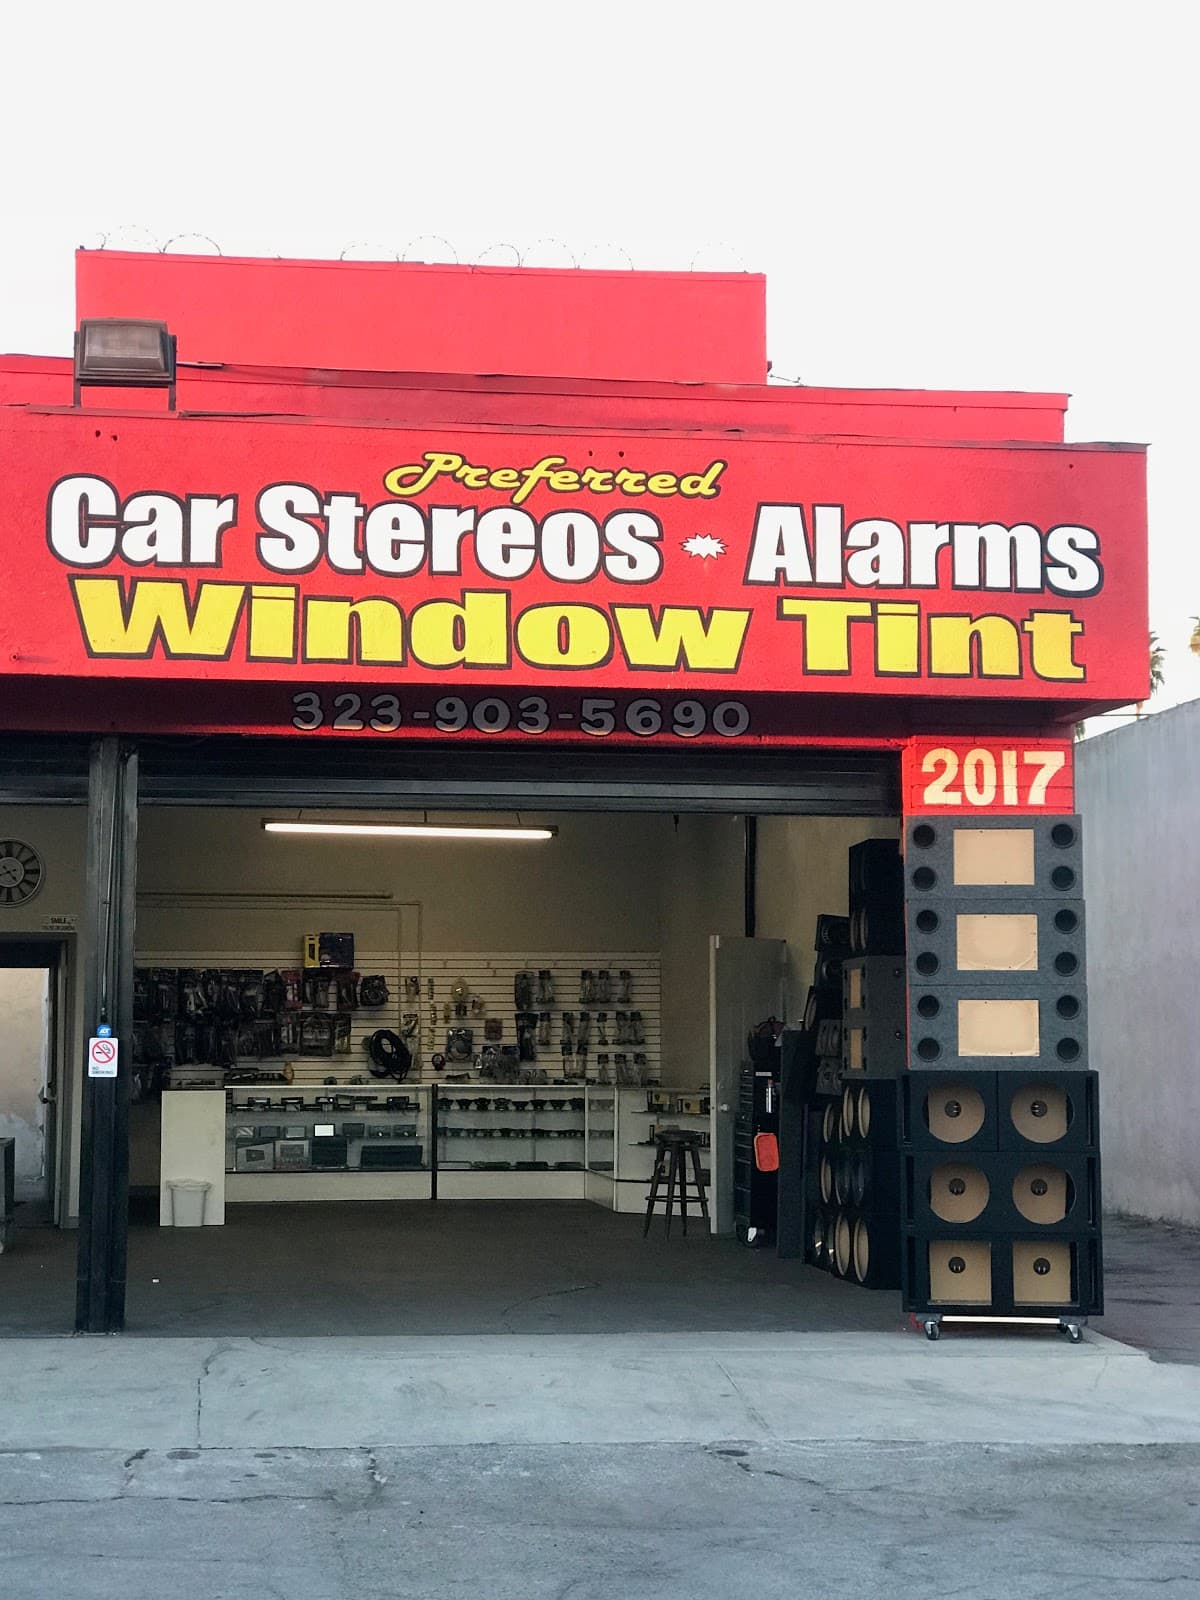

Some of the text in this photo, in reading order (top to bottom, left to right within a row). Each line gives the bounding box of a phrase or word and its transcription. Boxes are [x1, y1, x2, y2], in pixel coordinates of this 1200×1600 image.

[384, 452, 727, 504] Preferred
[48, 474, 1103, 596] Car Stereos Alarms
[69, 575, 1086, 682] Window Tint
[292, 691, 751, 738] 323-903-5690
[921, 748, 1065, 806] 2017
